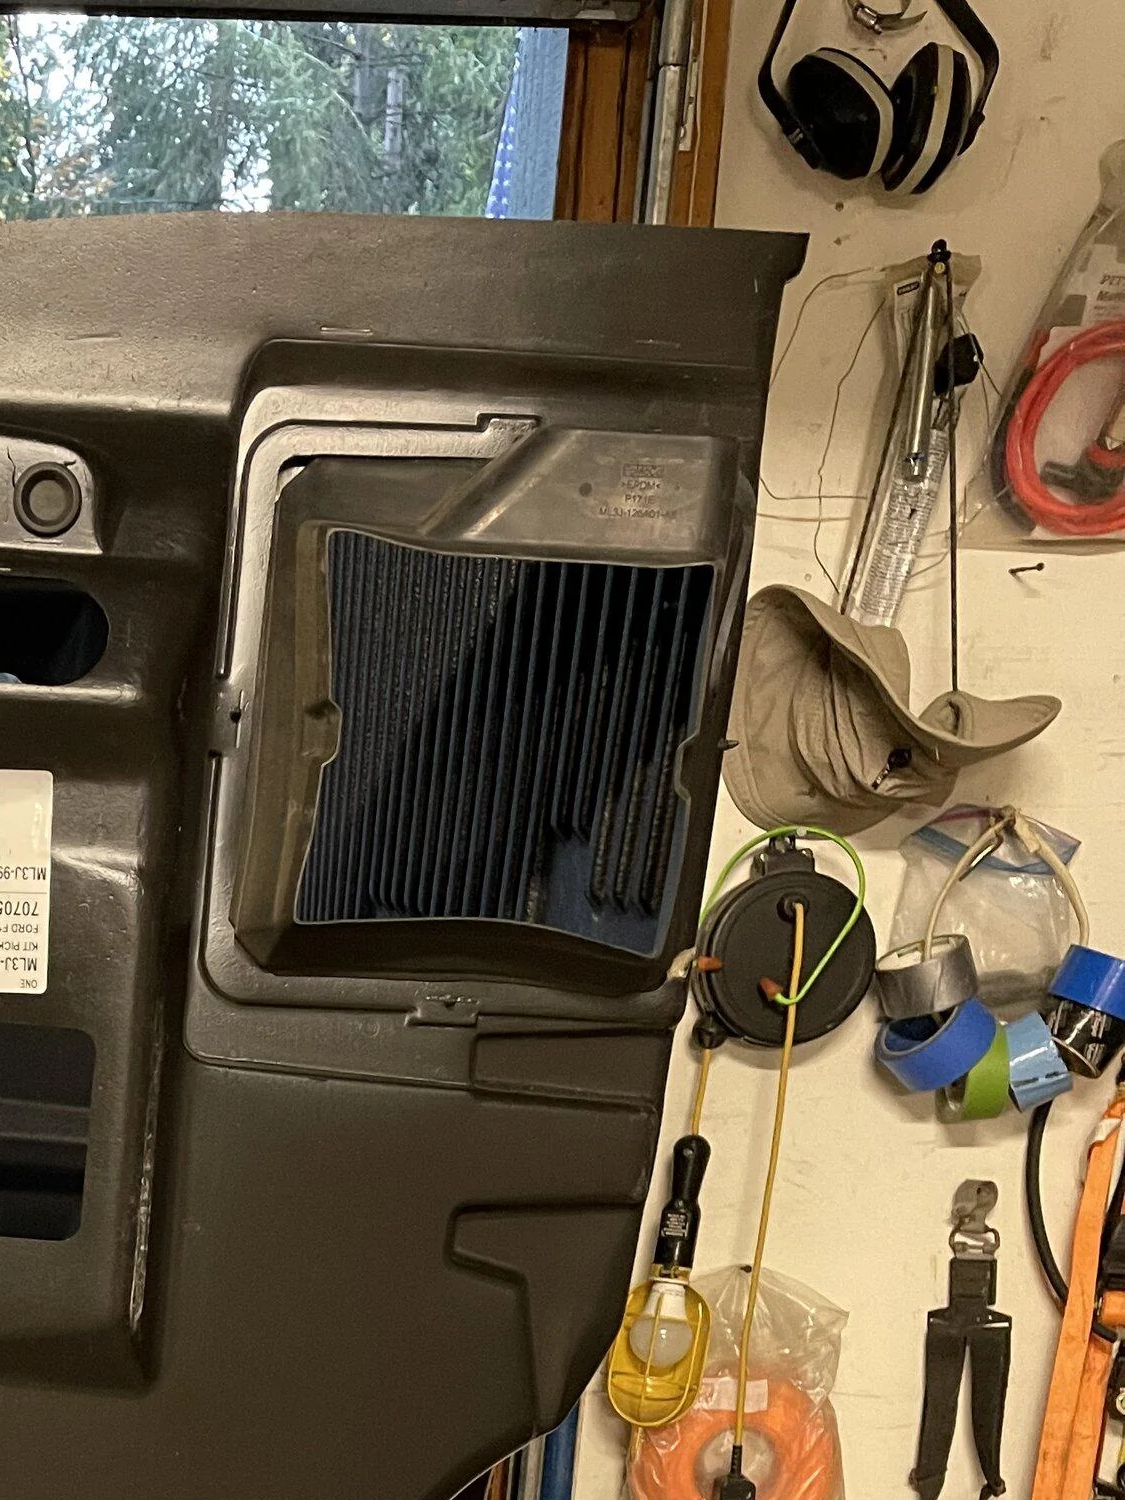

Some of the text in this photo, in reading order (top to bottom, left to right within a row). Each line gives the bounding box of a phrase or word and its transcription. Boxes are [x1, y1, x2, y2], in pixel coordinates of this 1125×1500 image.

[11, 923, 39, 934] FORD
[22, 941, 38, 952] KIT
[20, 978, 38, 989] ONE
